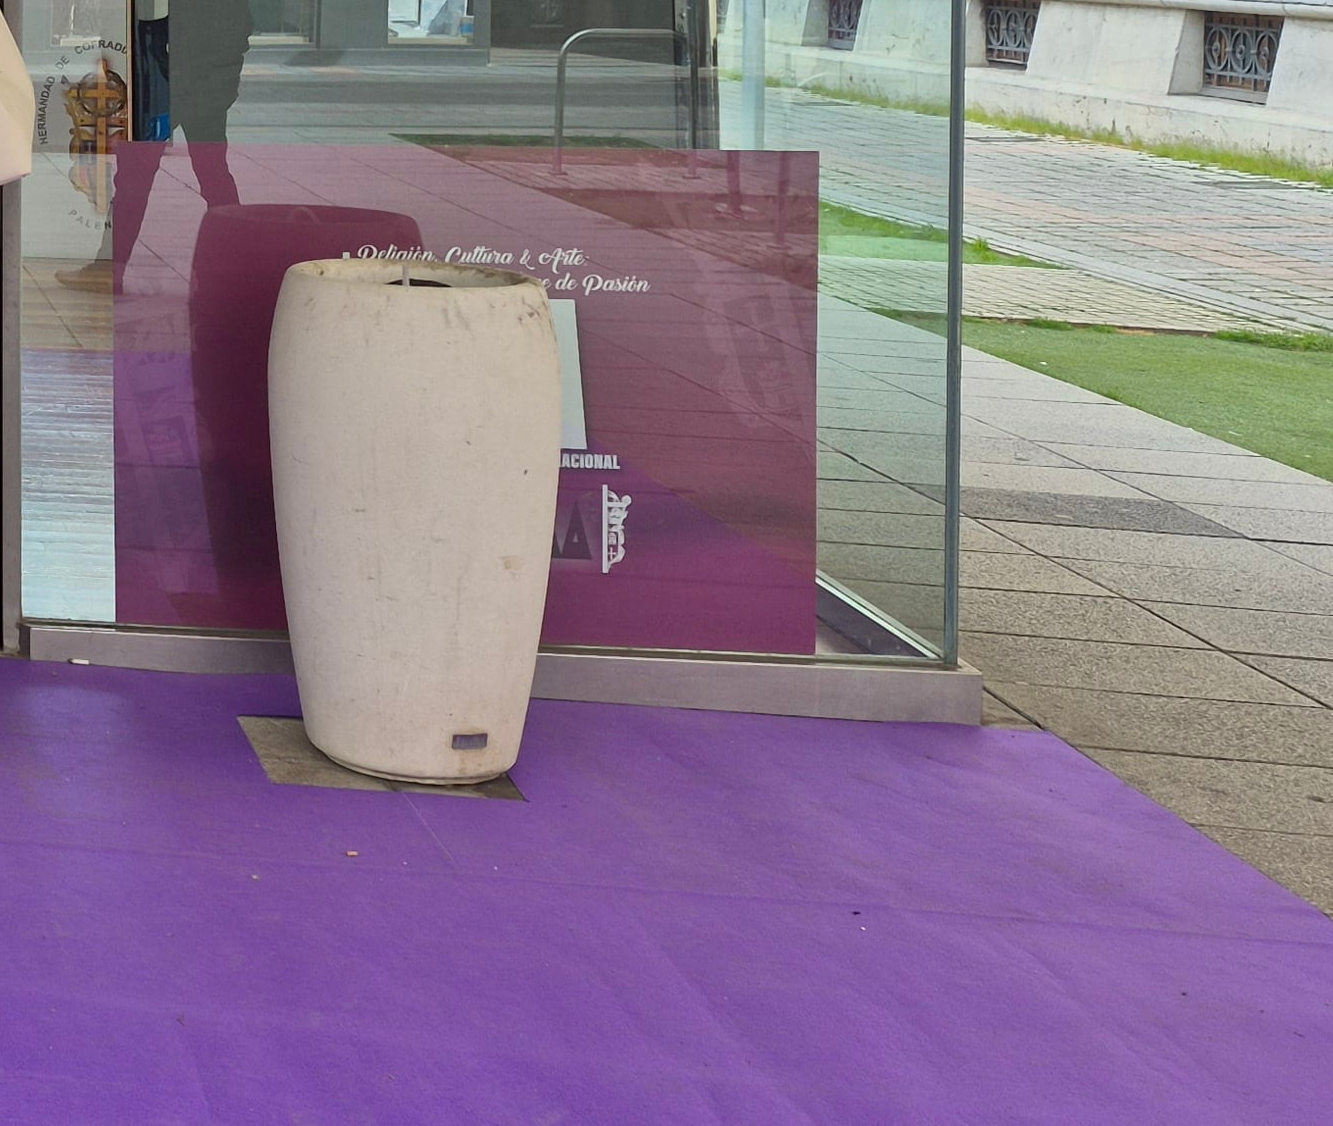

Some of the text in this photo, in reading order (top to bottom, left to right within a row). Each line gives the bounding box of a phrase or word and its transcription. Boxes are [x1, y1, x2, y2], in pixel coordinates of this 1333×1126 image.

[37, 76, 55, 145] HERMANDAD
[68, 209, 112, 230] PALEN
[444, 245, 515, 265] Cultura
[519, 248, 536, 270] &
[554, 272, 579, 290] de
[581, 273, 652, 296] Pasión
[561, 453, 621, 470] ACIONAL
